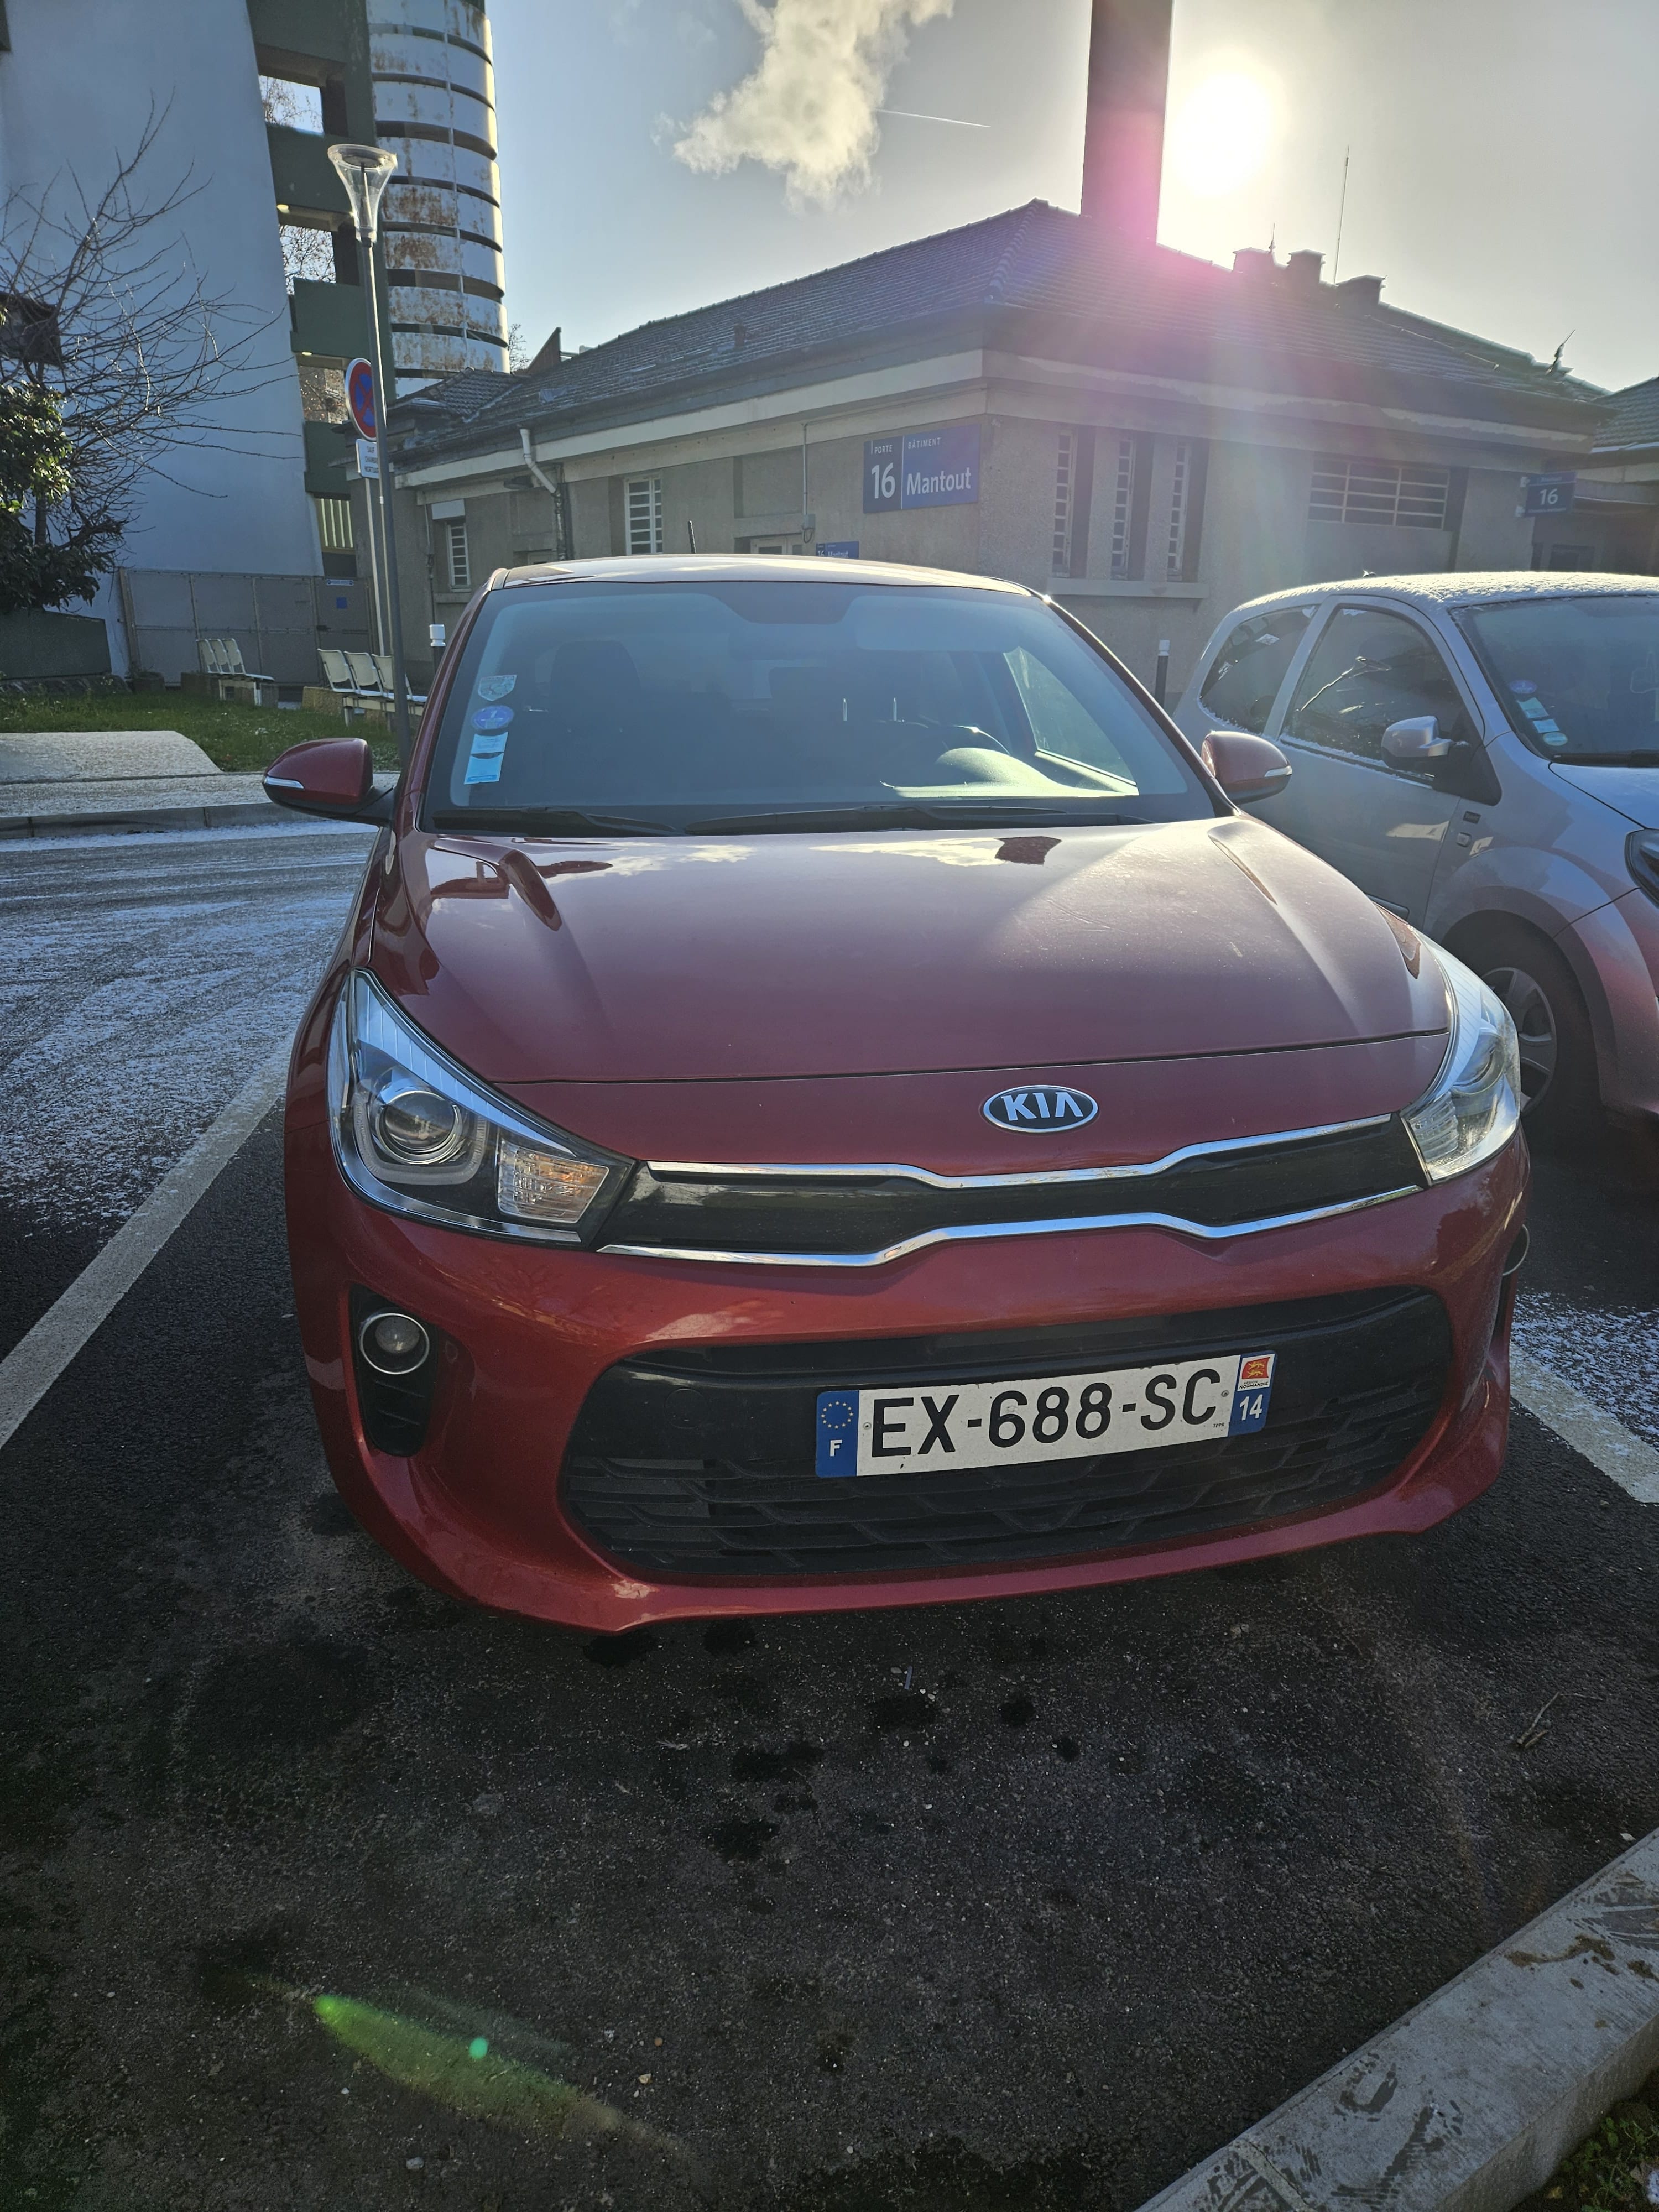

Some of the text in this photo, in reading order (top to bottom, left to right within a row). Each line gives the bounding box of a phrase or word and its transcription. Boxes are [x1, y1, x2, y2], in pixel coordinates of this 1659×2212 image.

[874, 445, 893, 455] PORTE
[907, 437, 941, 450] BÂTIMENT
[871, 462, 896, 499] 16
[906, 467, 972, 496] Mantout
[1540, 488, 1558, 505] 16
[1001, 1092, 1084, 1121] KIA
[1239, 1381, 1269, 1390] NORMANDIE
[871, 1368, 1221, 1458] EX-688-SC
[1239, 1394, 1263, 1421] 14
[830, 1439, 843, 1457] F
